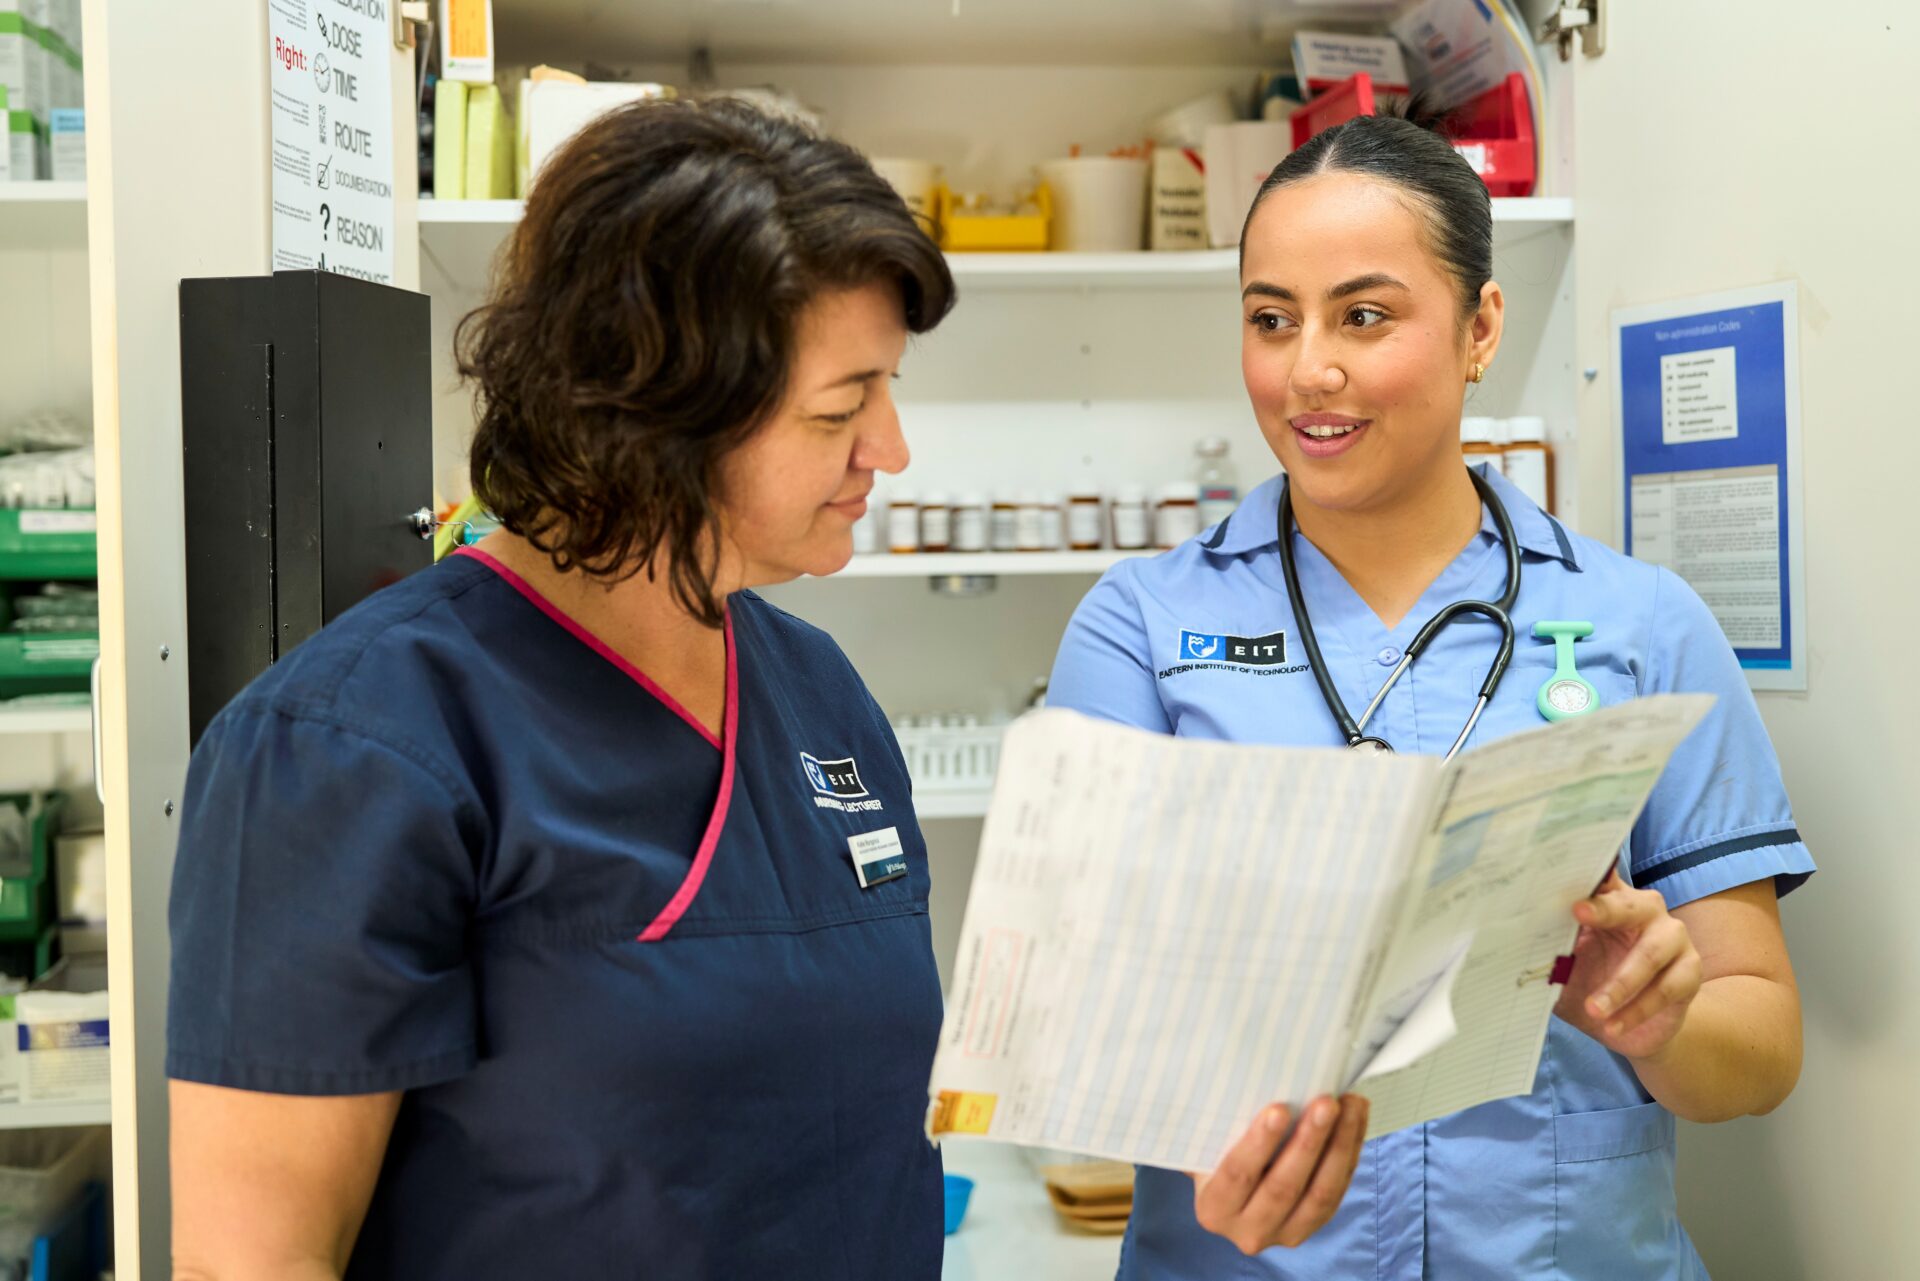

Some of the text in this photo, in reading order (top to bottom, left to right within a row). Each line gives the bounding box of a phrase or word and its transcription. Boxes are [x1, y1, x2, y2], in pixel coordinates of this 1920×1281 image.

[332, 0, 385, 22] CATION
[275, 36, 308, 71] Right:
[332, 22, 362, 59] DOSE
[333, 68, 358, 102] TIME
[334, 120, 372, 158] ROUTE
[335, 169, 391, 198] DOCUMENTATION
[337, 216, 383, 252] REASON
[1234, 645, 1277, 657] EIT
[1159, 664, 1194, 680] EASTERN
[1195, 663, 1237, 672] INSTITUTE
[1253, 664, 1310, 676] TECHNOLOGY
[828, 773, 856, 786] EIT
[844, 799, 883, 812] LECTURER
